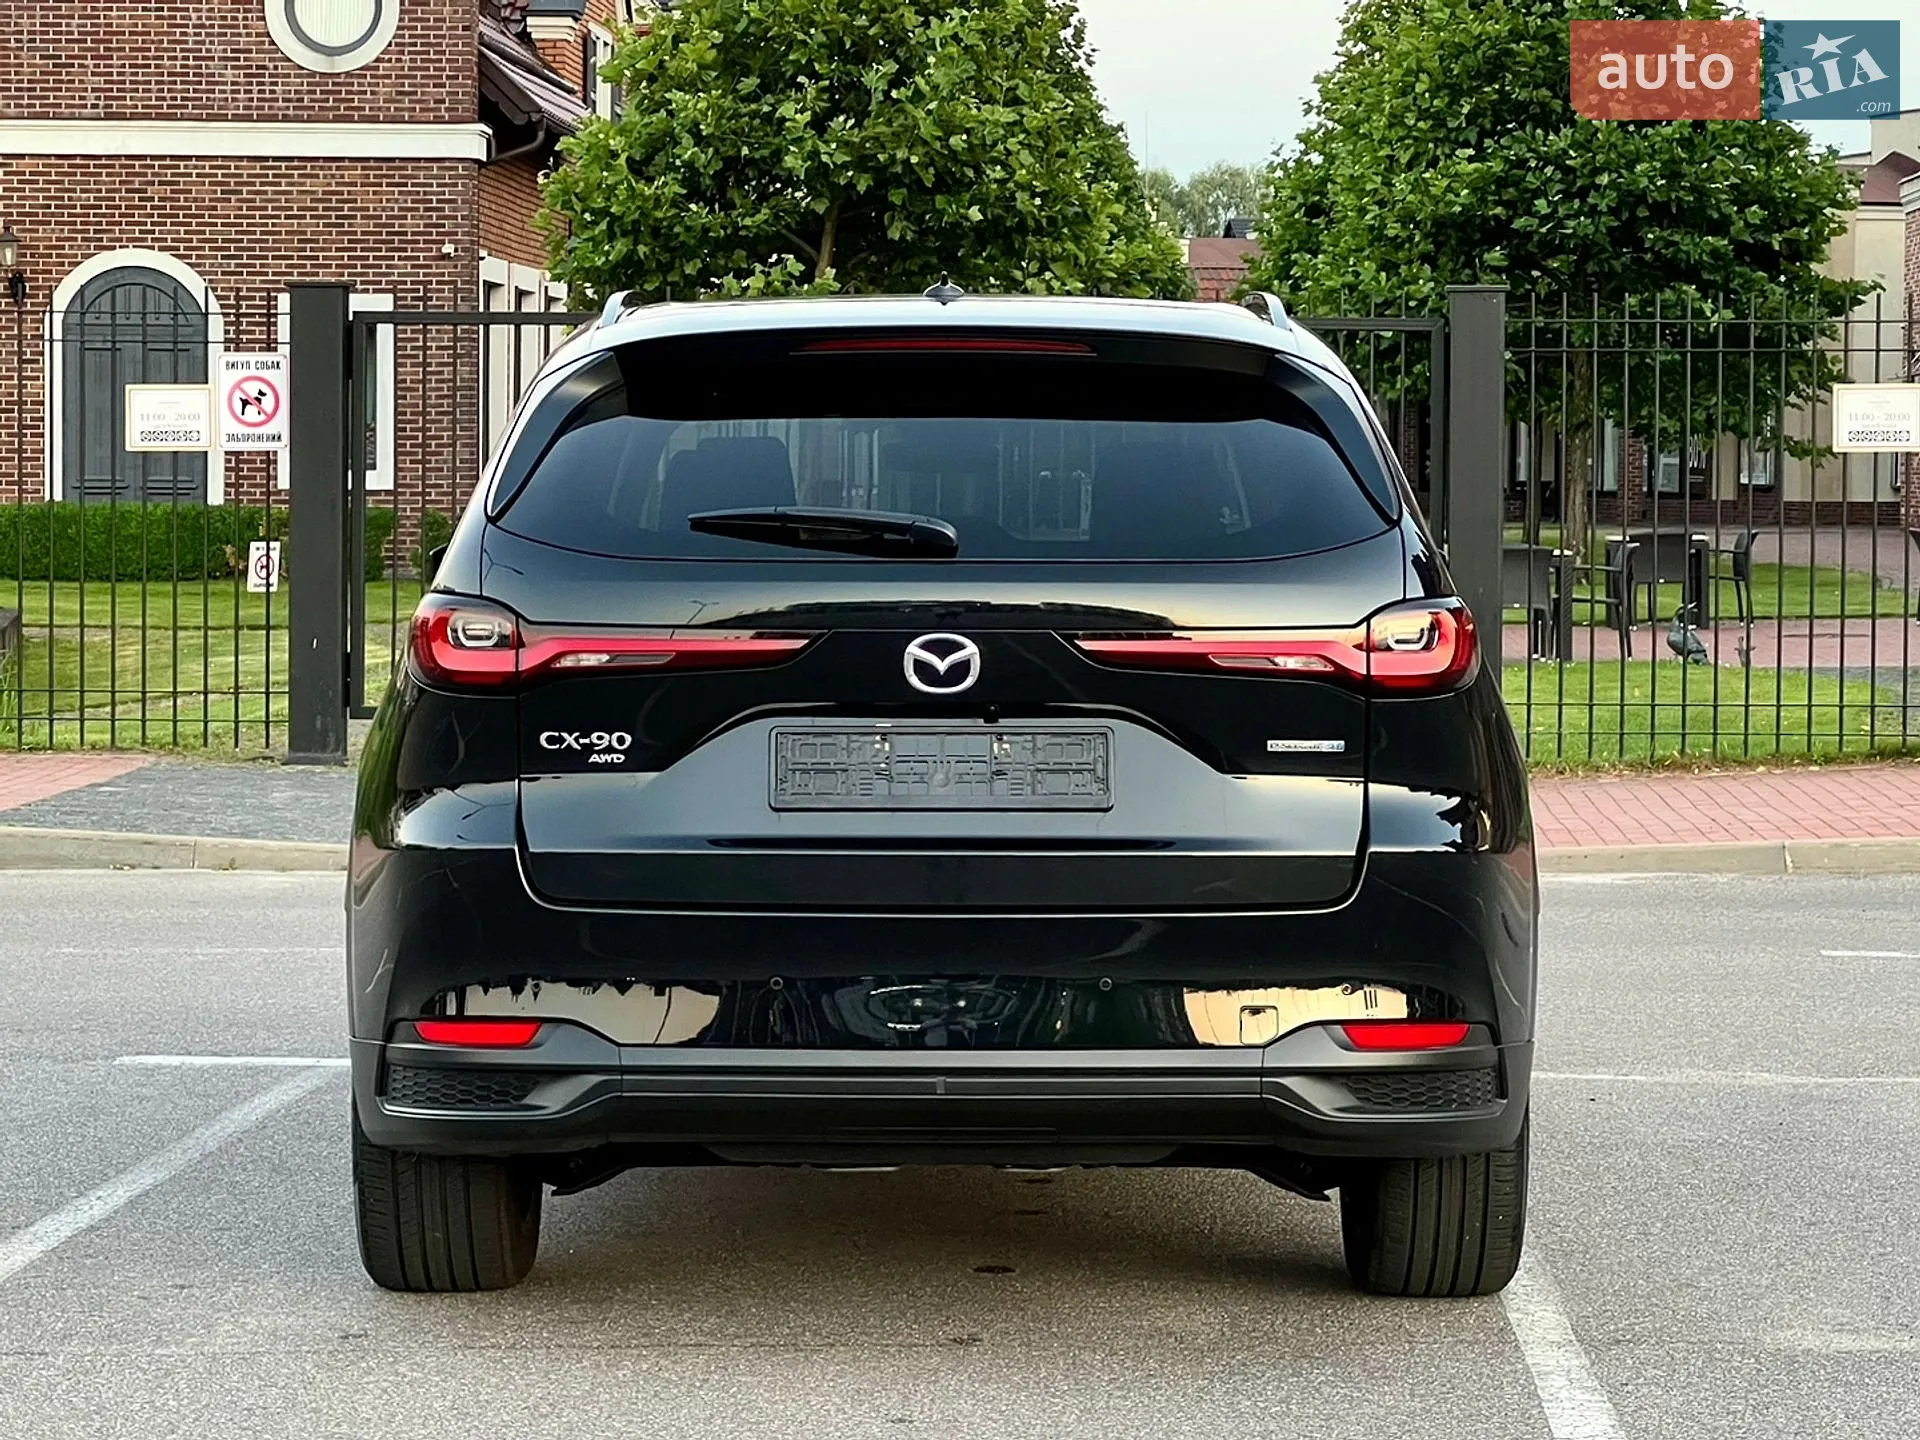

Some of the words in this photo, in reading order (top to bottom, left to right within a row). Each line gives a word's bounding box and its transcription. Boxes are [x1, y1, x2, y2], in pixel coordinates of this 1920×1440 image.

[255, 360, 281, 371] СОБАК
[225, 431, 282, 443] ЗАБОРОНЕНИЙ
[539, 731, 632, 750] CX-90
[588, 753, 626, 763] AWD
